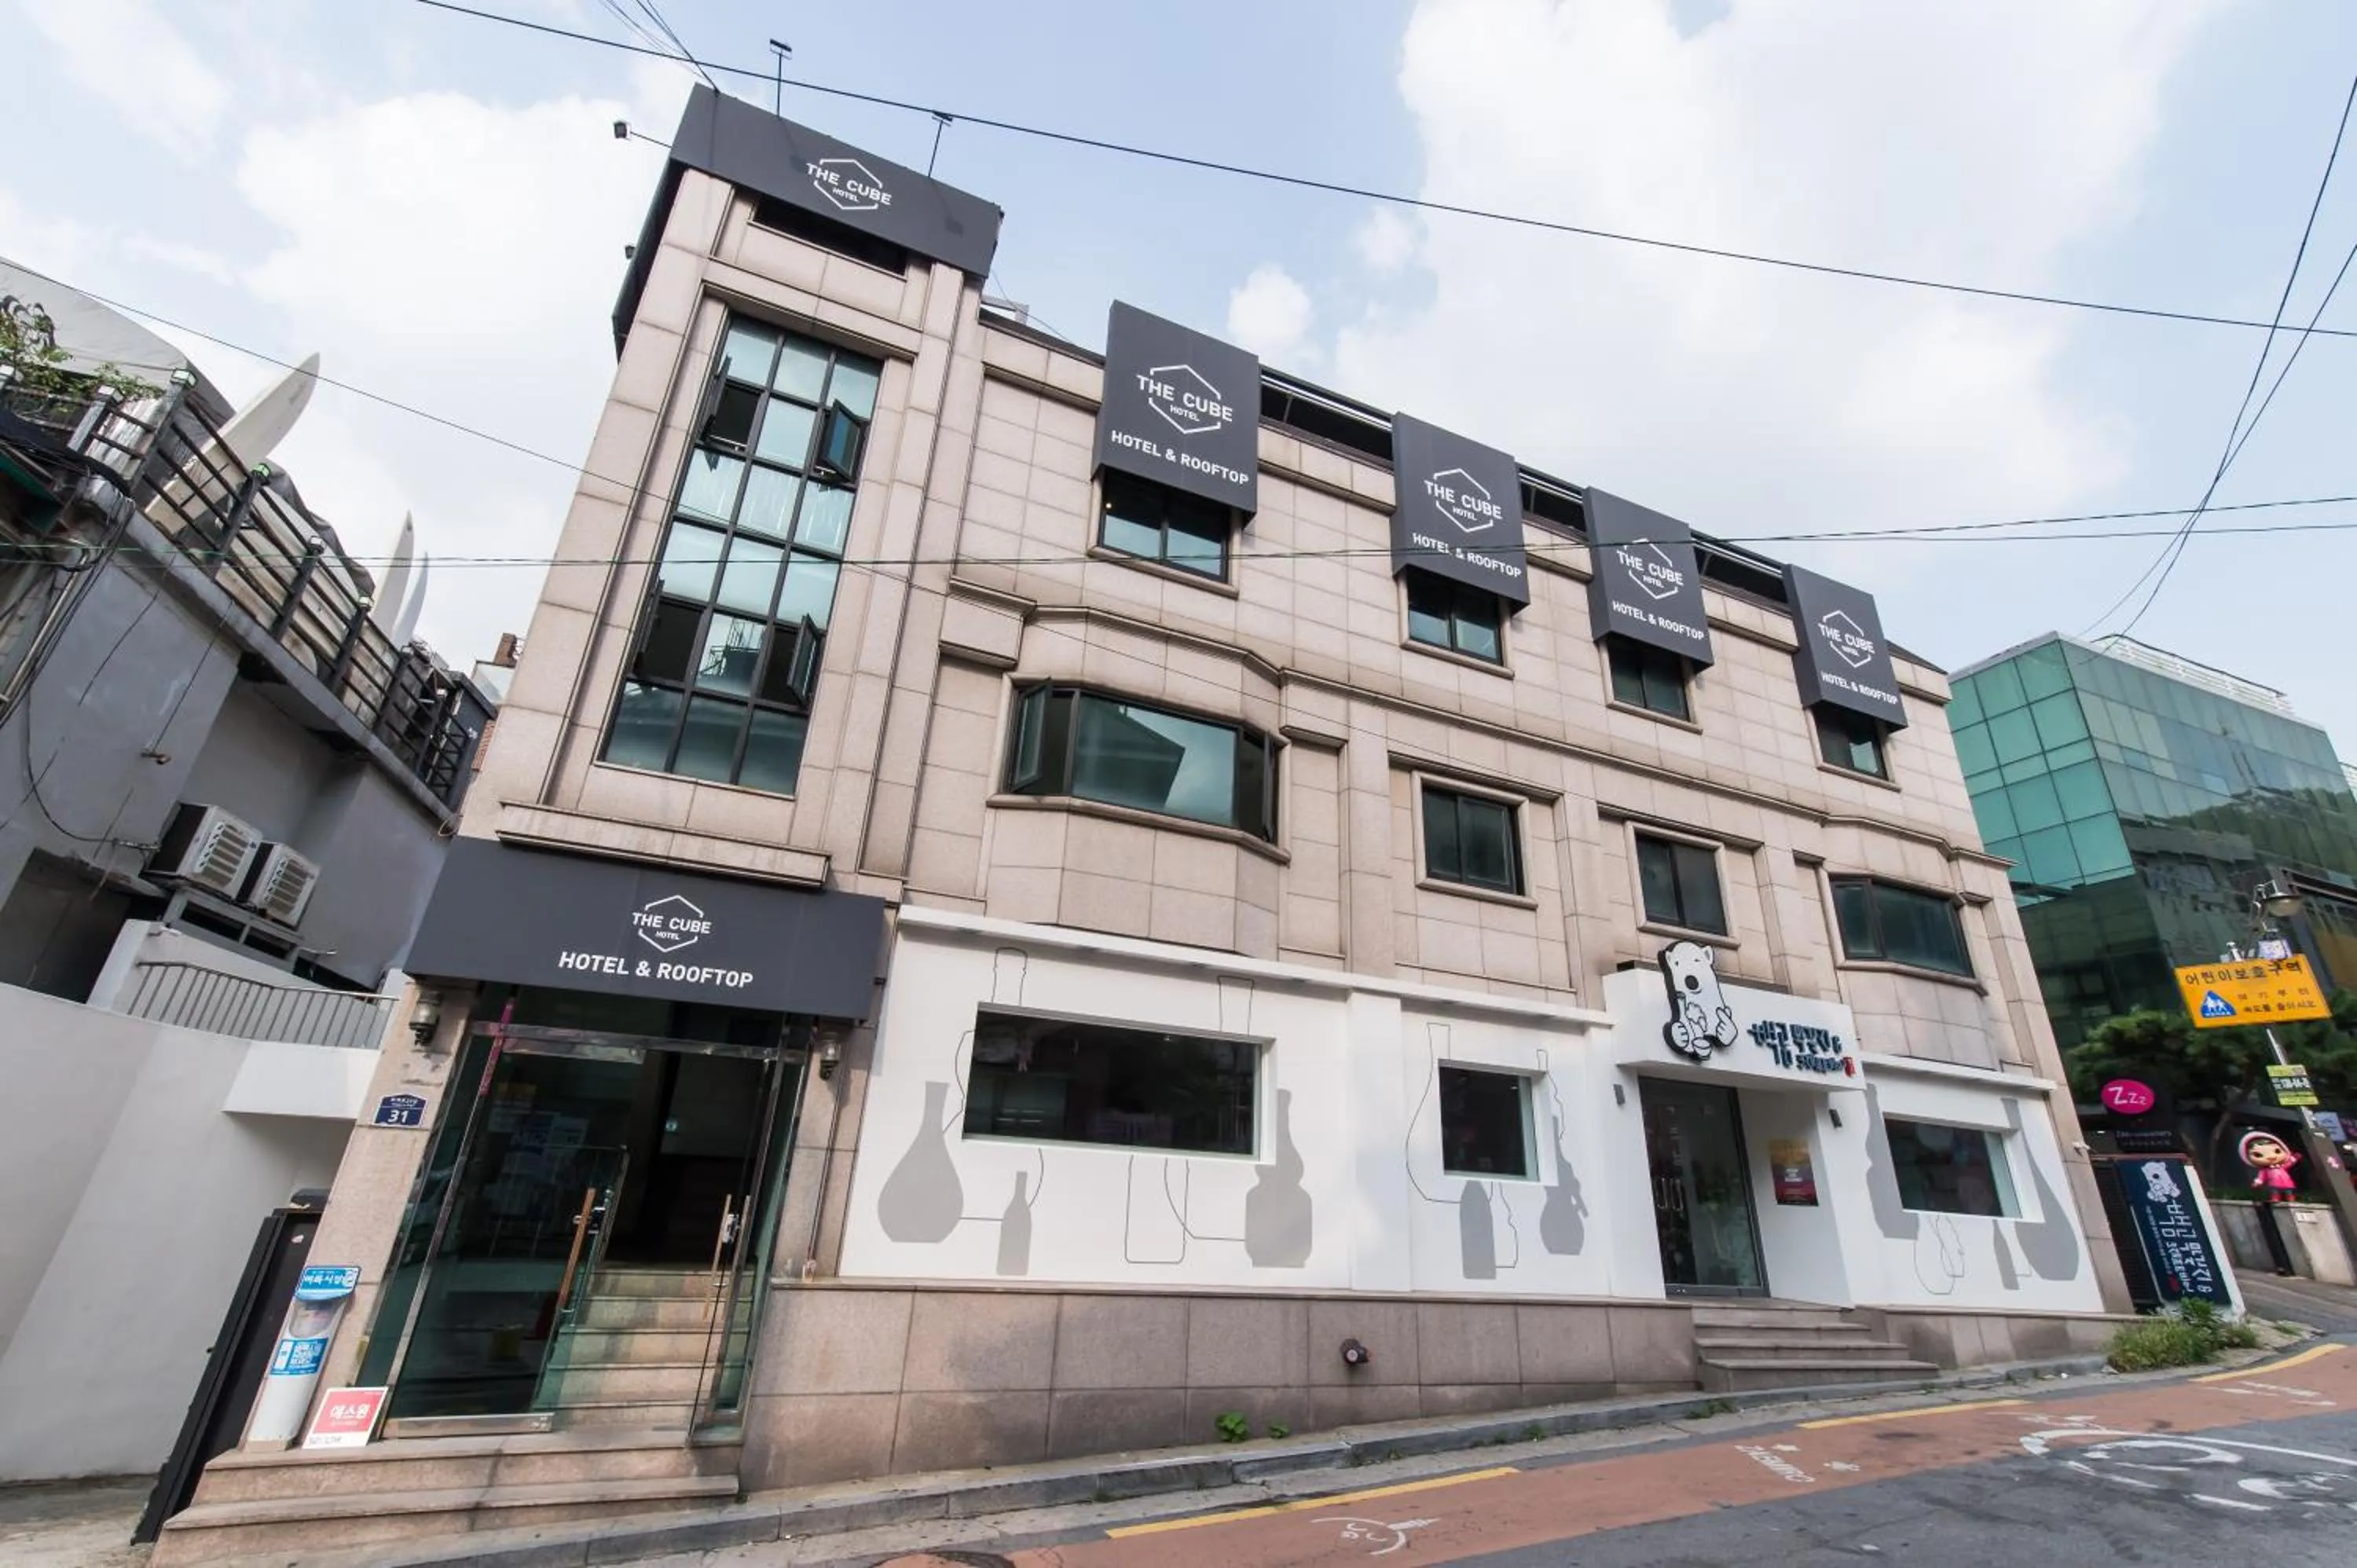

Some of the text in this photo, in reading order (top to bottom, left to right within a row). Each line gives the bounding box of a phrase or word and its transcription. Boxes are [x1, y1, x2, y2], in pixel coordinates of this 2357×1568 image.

[806, 163, 893, 205] THE CUBE
[832, 187, 860, 203] HOTEL
[1137, 375, 1233, 422] THE CUBE
[1170, 405, 1200, 422] HOTEL
[1111, 430, 1249, 485] HOTEL & ROOFTOP
[1424, 480, 1502, 519] THE CUBE
[1453, 507, 1477, 521] HOTEL
[1413, 533, 1452, 555] HOTEL
[1467, 553, 1521, 577] ROOFTOP
[1616, 550, 1684, 586] THE CUBE
[1612, 600, 1647, 621] HOTEL
[1658, 617, 1704, 640] ROOFTOP
[1818, 623, 1842, 642] THE
[632, 912, 712, 933] THE CUBE
[655, 931, 680, 940] HOTEL
[558, 951, 753, 988] HOTEL & ROOFTOP
[387, 1109, 409, 1123] 31
